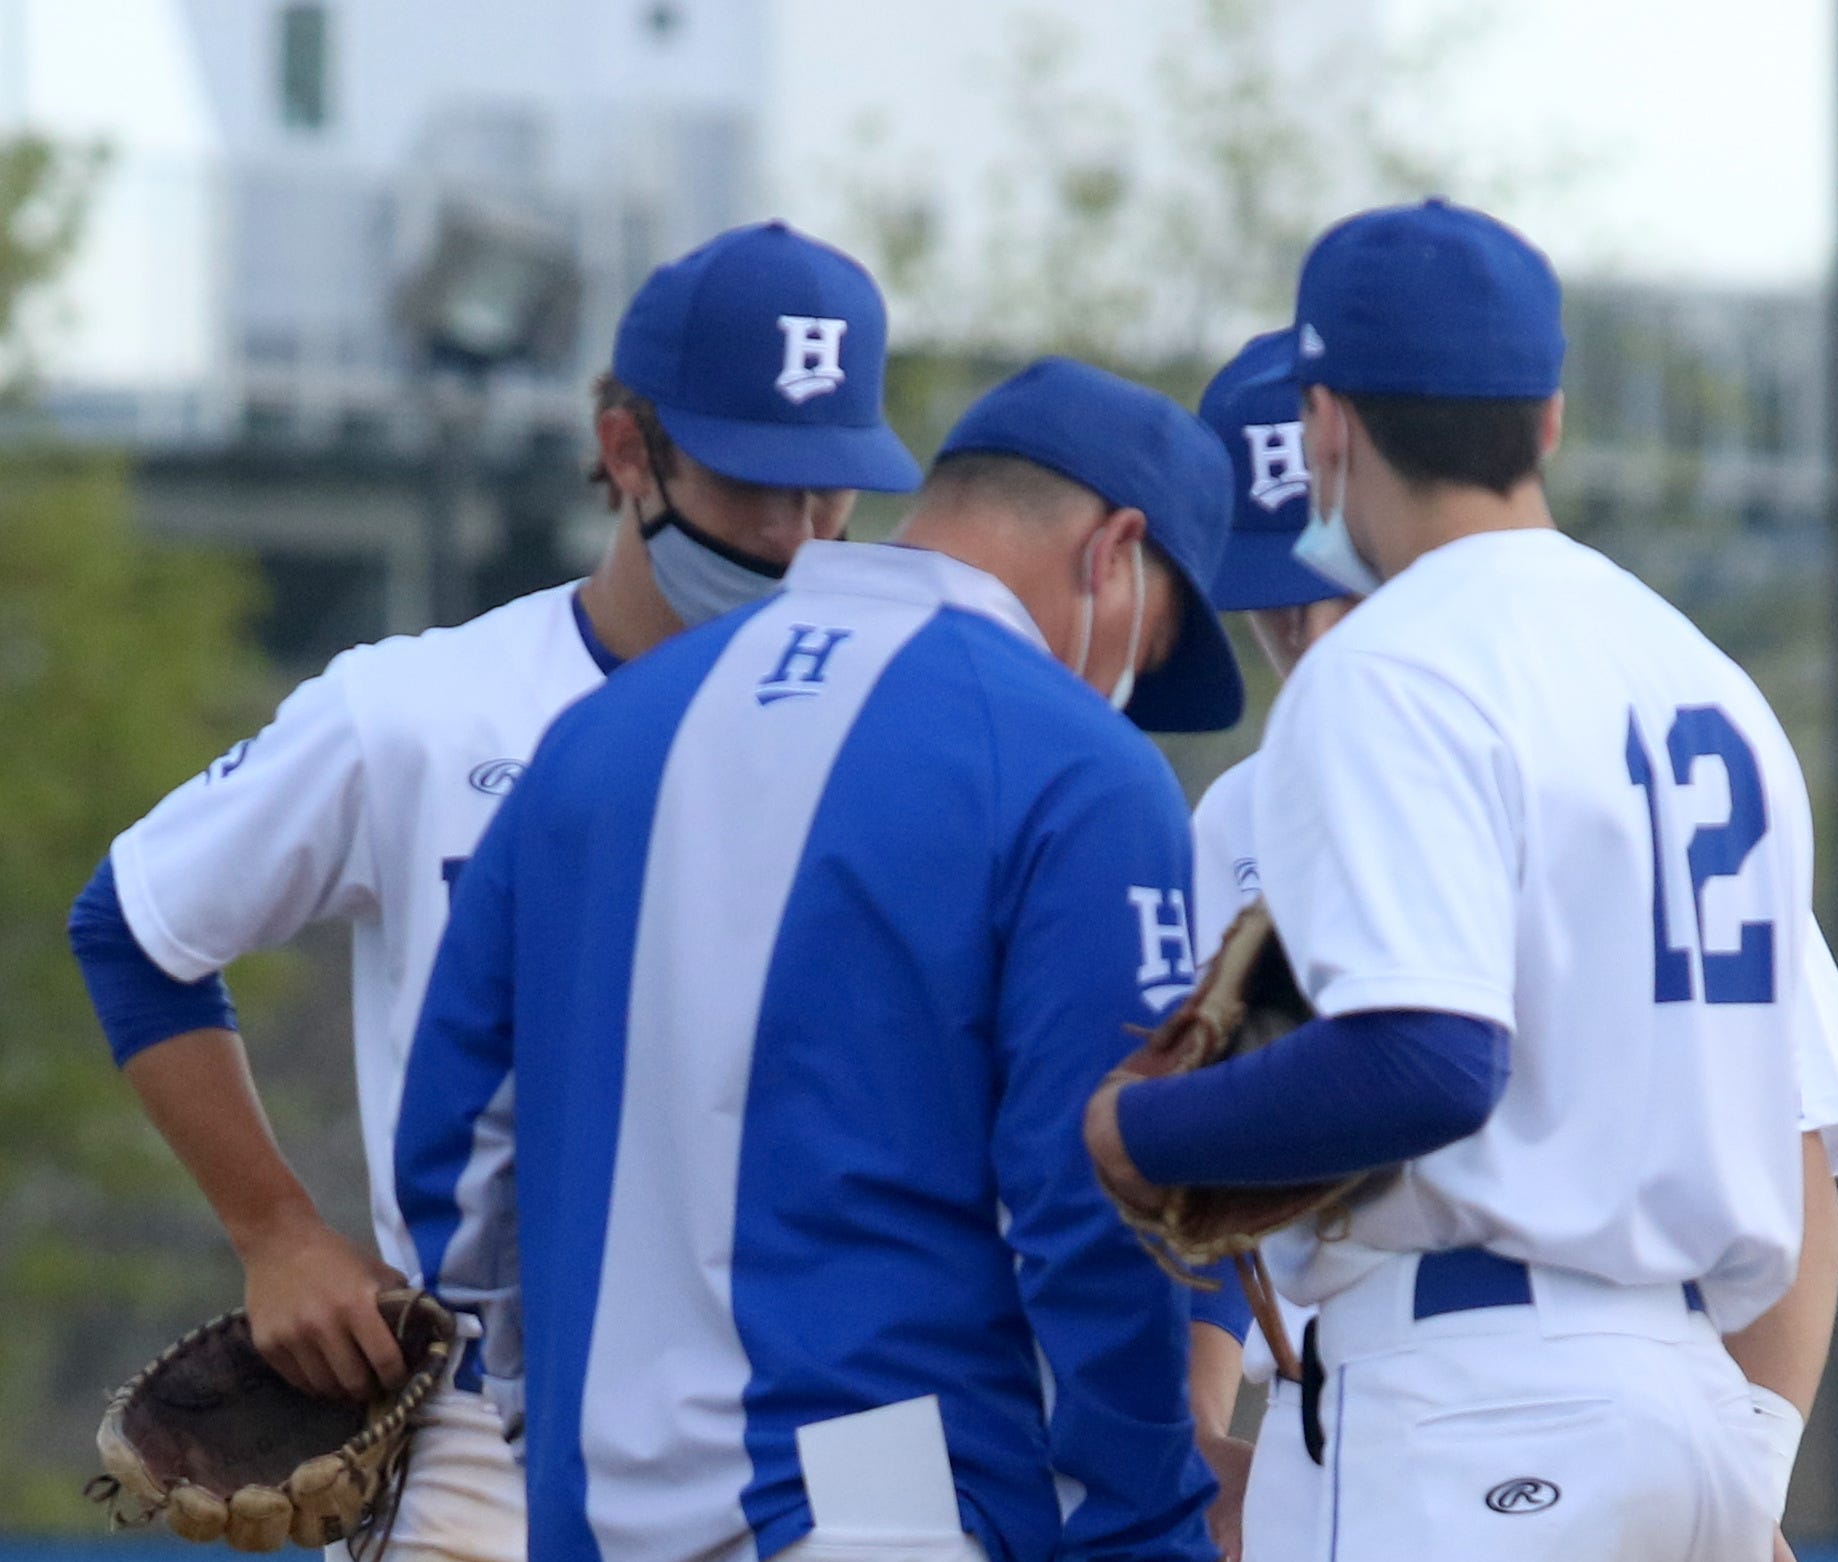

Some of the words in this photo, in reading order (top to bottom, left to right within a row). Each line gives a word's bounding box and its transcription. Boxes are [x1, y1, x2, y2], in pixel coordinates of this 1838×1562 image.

[776, 314, 848, 404] H
[1243, 420, 1311, 512] H
[756, 623, 855, 707] H
[1624, 703, 1778, 1004] 12
[1127, 884, 1196, 1012] H
